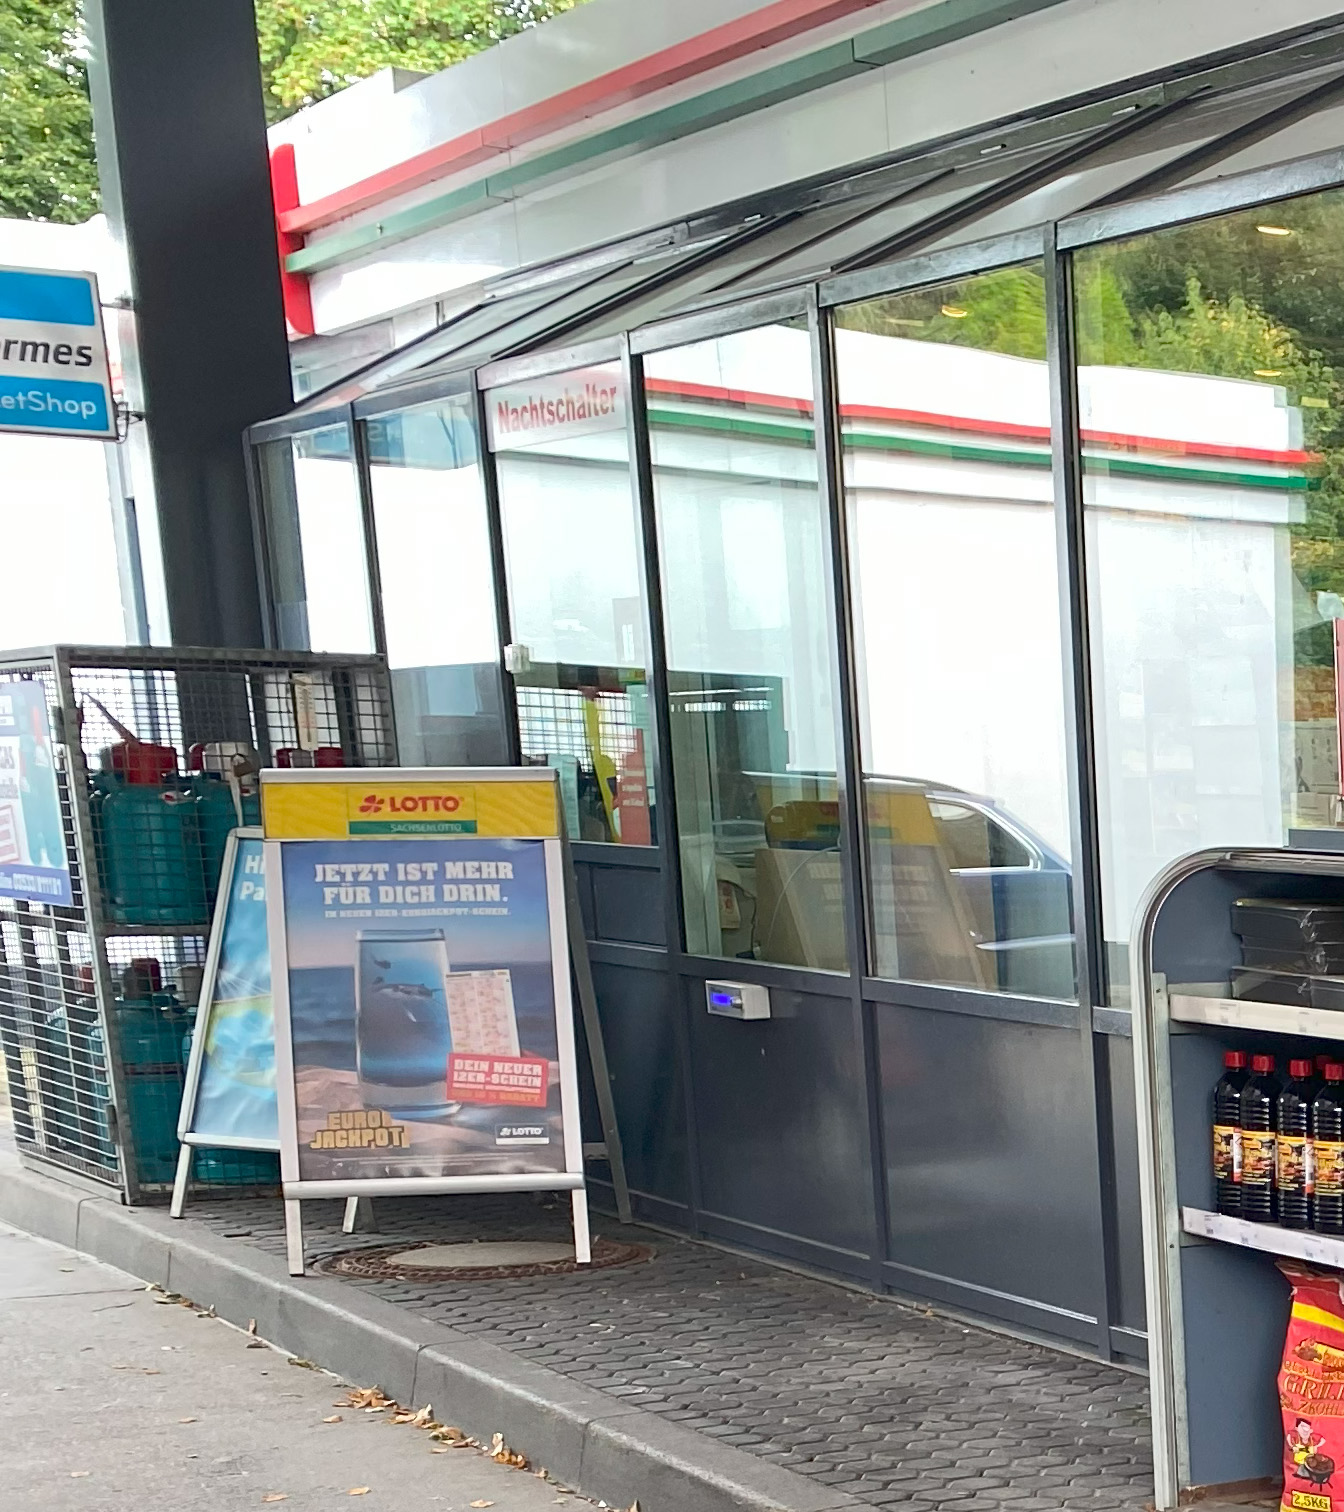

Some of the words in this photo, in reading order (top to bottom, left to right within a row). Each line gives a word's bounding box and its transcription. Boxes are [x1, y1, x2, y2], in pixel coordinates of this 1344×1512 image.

[0, 338, 93, 366] rmes
[0, 390, 97, 419] etShop
[498, 383, 617, 433] Nachtschalter
[389, 796, 459, 813] LOTTO
[391, 823, 462, 833] SACHSENLOTTO
[315, 863, 389, 882] JETZT
[398, 862, 438, 880] IST
[445, 861, 514, 879] MEHR
[323, 883, 372, 905] FÜR
[379, 885, 435, 903] DICH
[442, 884, 509, 902] DRIN.
[454, 1059, 489, 1072] DEIN
[493, 1061, 542, 1075] NEUER
[328, 1110, 384, 1129] EURO
[310, 1126, 404, 1149] JACKPOT
